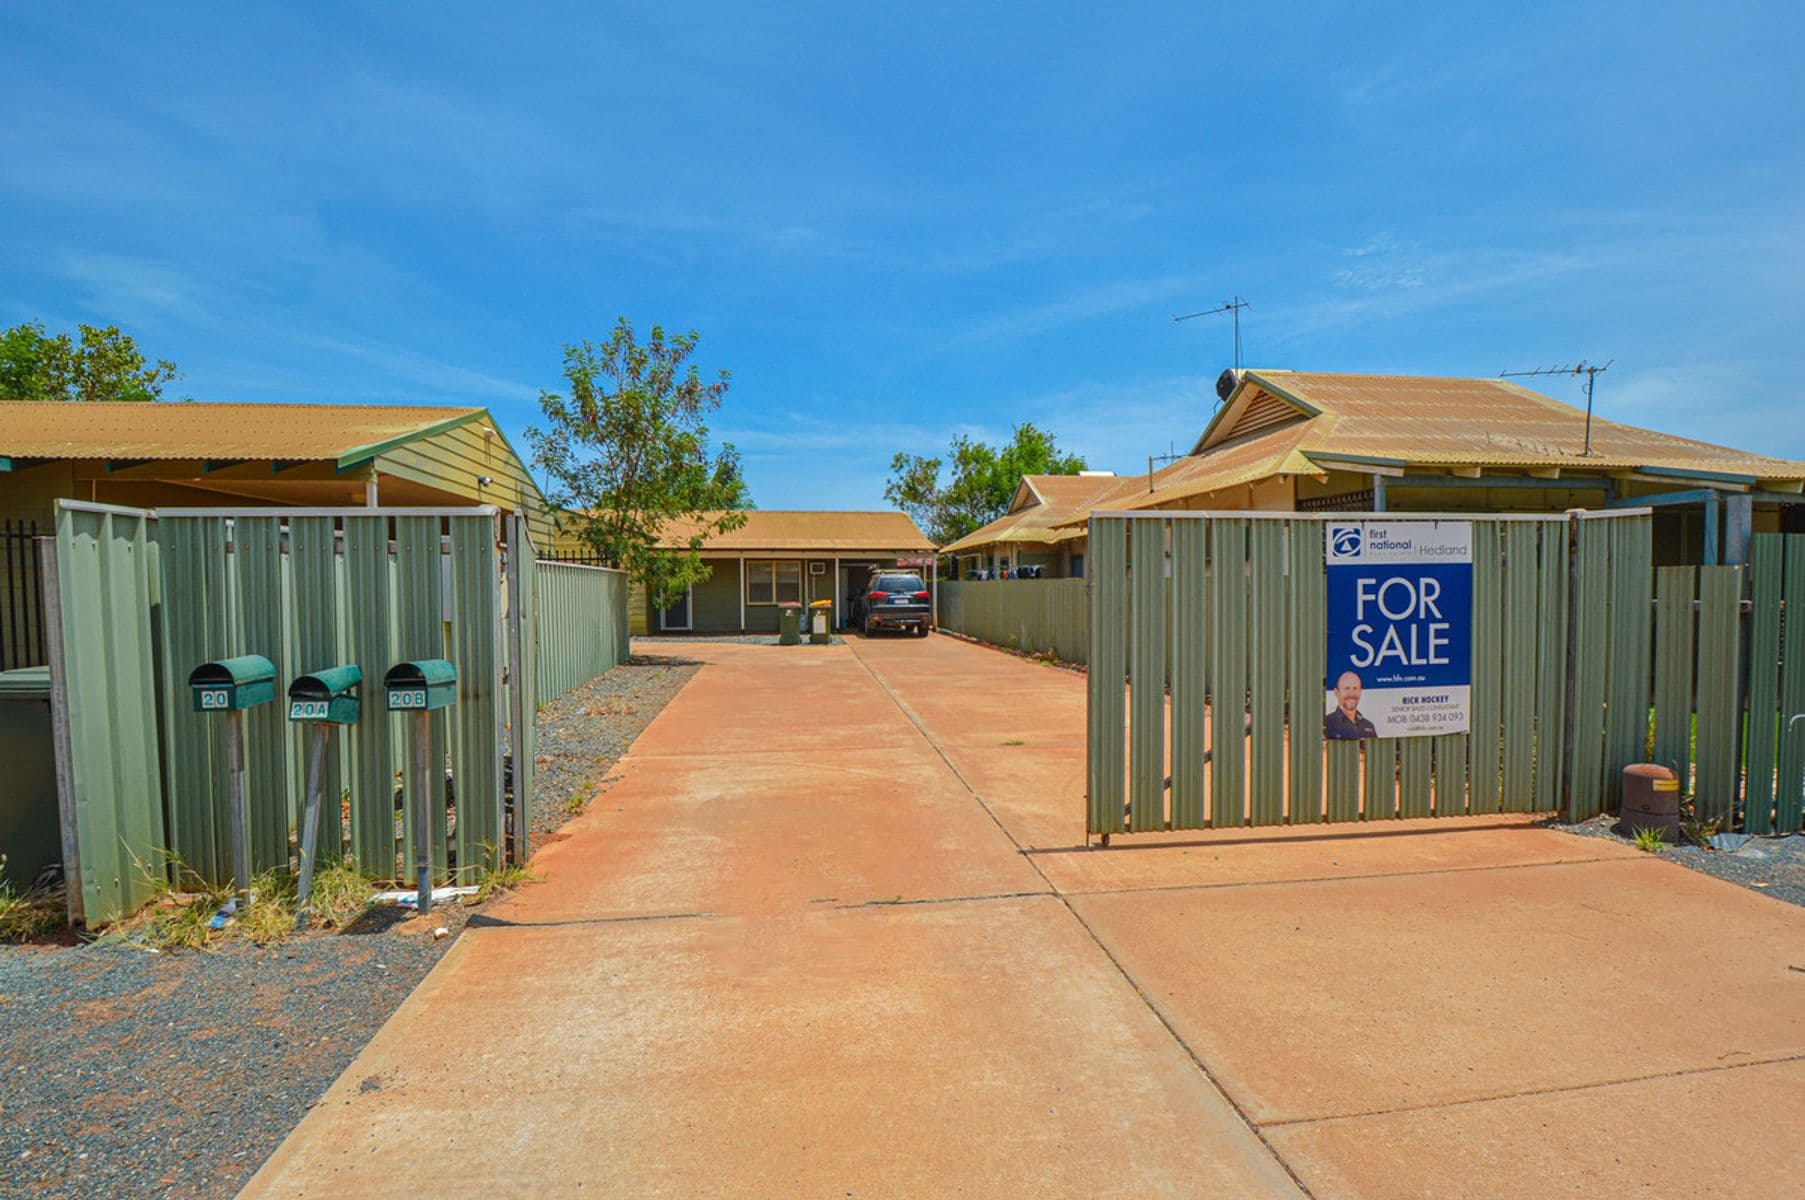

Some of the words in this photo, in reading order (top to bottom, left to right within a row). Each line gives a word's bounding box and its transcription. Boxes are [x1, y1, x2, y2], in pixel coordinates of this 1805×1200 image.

[1369, 529, 1387, 539] first
[1369, 540, 1412, 550] national
[1419, 544, 1467, 556] Hedland
[1357, 577, 1442, 621] FOR
[1350, 622, 1450, 668] SALE
[203, 692, 226, 706] 20
[391, 693, 424, 705] 20B
[1402, 696, 1419, 704] RICK
[1421, 695, 1450, 703] HOCKEY
[293, 702, 326, 716] 20A
[1387, 715, 1408, 724] MOB
[1409, 713, 1430, 723] 0438
[1432, 713, 1447, 722] 934
[1448, 712, 1465, 721] 093
